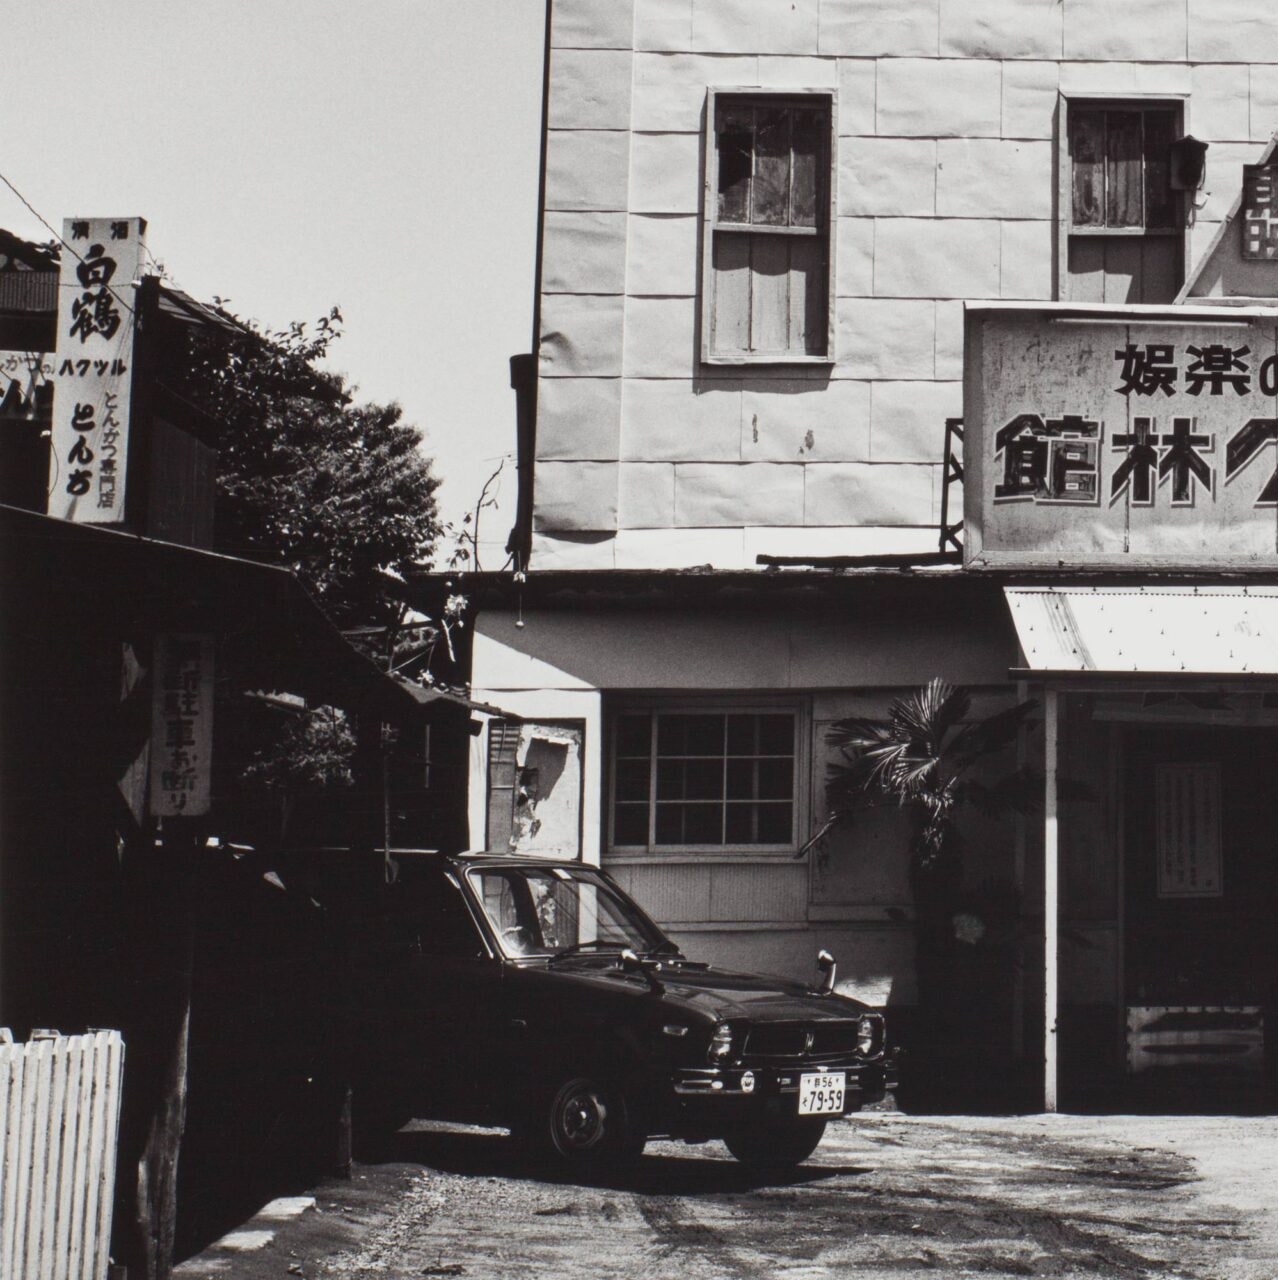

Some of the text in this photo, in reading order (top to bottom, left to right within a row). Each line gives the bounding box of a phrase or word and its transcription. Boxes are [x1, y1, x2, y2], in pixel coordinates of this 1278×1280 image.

[69, 244, 122, 345] 白鶴
[59, 358, 127, 377] ハクツル
[97, 390, 120, 509] とんかつ専門店
